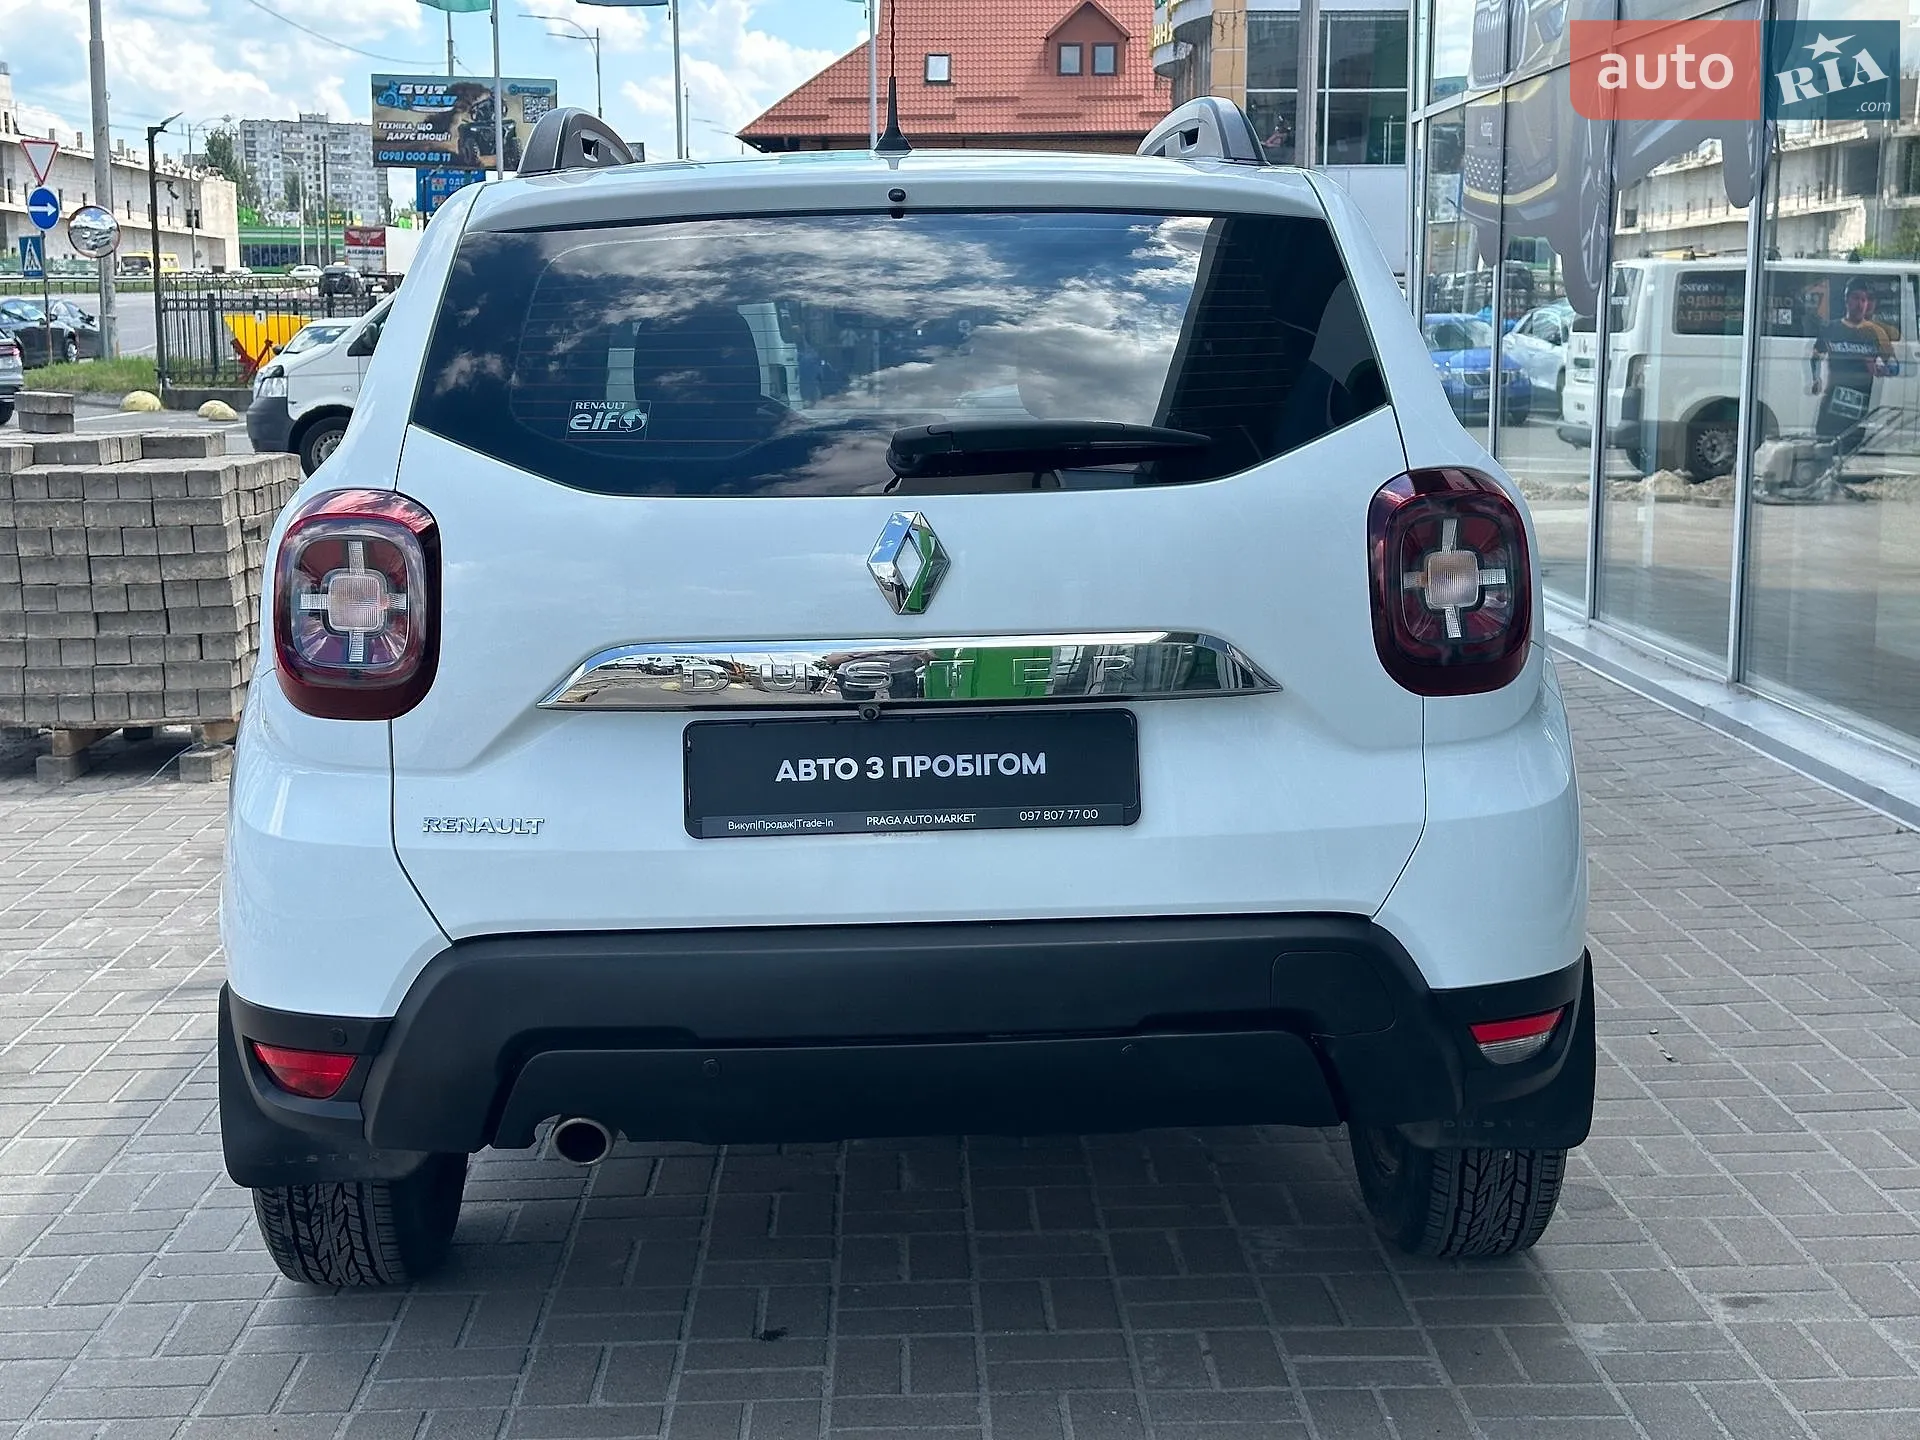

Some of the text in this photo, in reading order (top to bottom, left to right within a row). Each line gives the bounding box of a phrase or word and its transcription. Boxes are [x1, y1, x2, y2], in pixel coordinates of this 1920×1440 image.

[378, 122, 433, 131] ТЕХНІКА, ЩО
[387, 132, 416, 141] ДАРУЄ
[378, 151, 404, 161] (098)
[406, 152, 426, 161] 000
[442, 153, 451, 162] 11
[575, 401, 626, 410] RENAULT
[569, 412, 620, 430] elf
[685, 653, 1138, 692] DUSTER
[775, 757, 859, 782] АВТО
[892, 752, 1046, 778] ПРОБІГОМ
[423, 816, 545, 834] RENAULT
[866, 815, 902, 826] PRAGA
[903, 814, 933, 825] AUTO
[934, 813, 977, 824] MARKET
[1019, 811, 1041, 821] 097
[1043, 810, 1065, 821] 807
[1067, 809, 1081, 820] 77
[1082, 809, 1099, 819] 00
